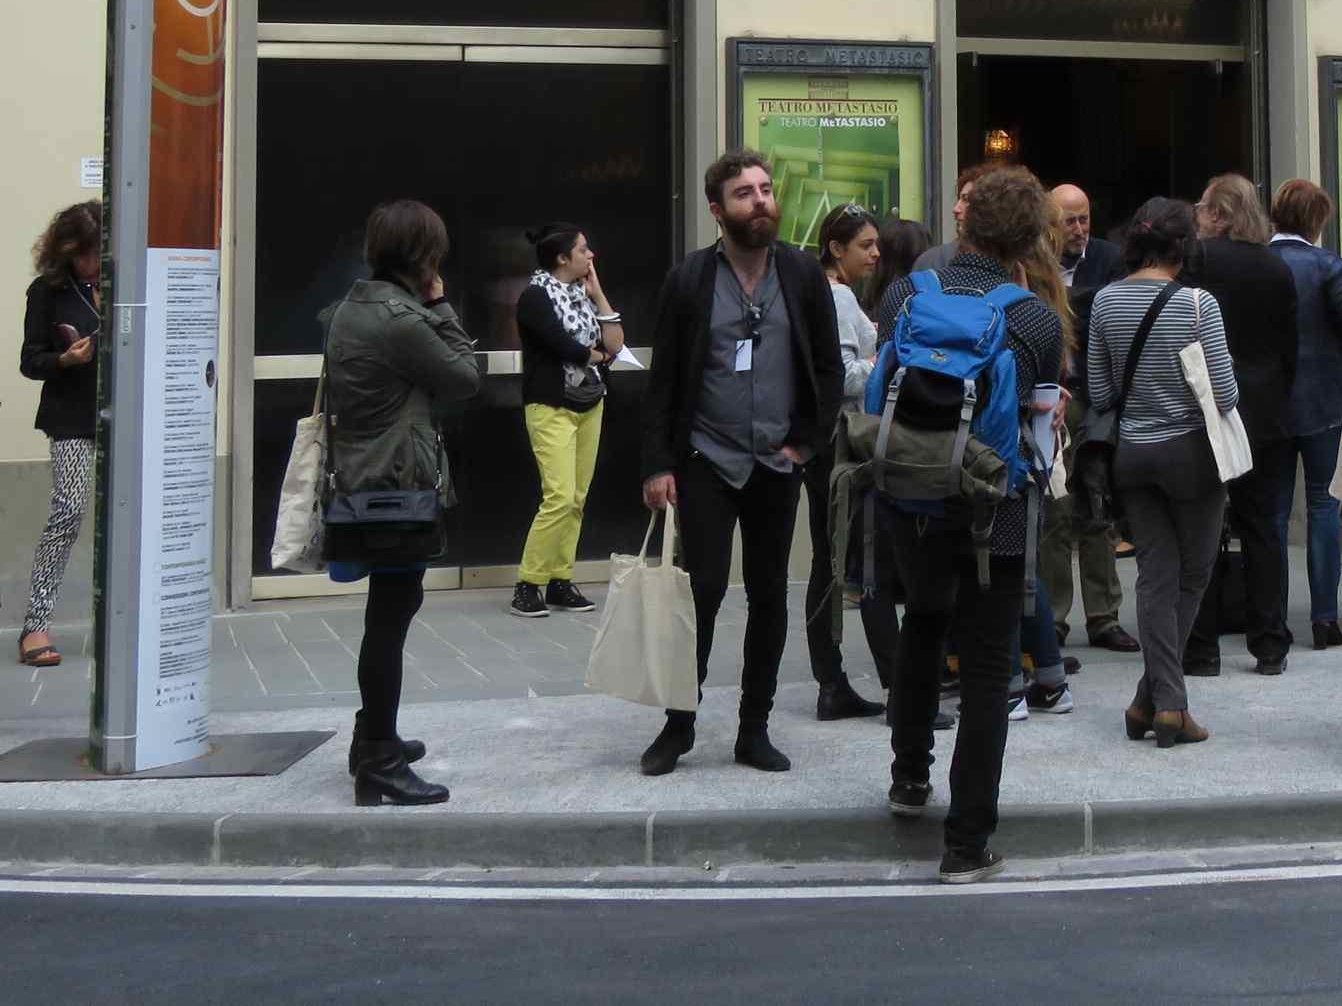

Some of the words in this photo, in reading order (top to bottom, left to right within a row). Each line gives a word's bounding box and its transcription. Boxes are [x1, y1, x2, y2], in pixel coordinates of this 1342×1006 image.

[744, 48, 809, 64] TEATRO
[824, 48, 924, 66] METASTASIO
[759, 101, 812, 114] TEATRO
[816, 102, 898, 115] METASTASIO
[780, 116, 817, 127] TEATRO
